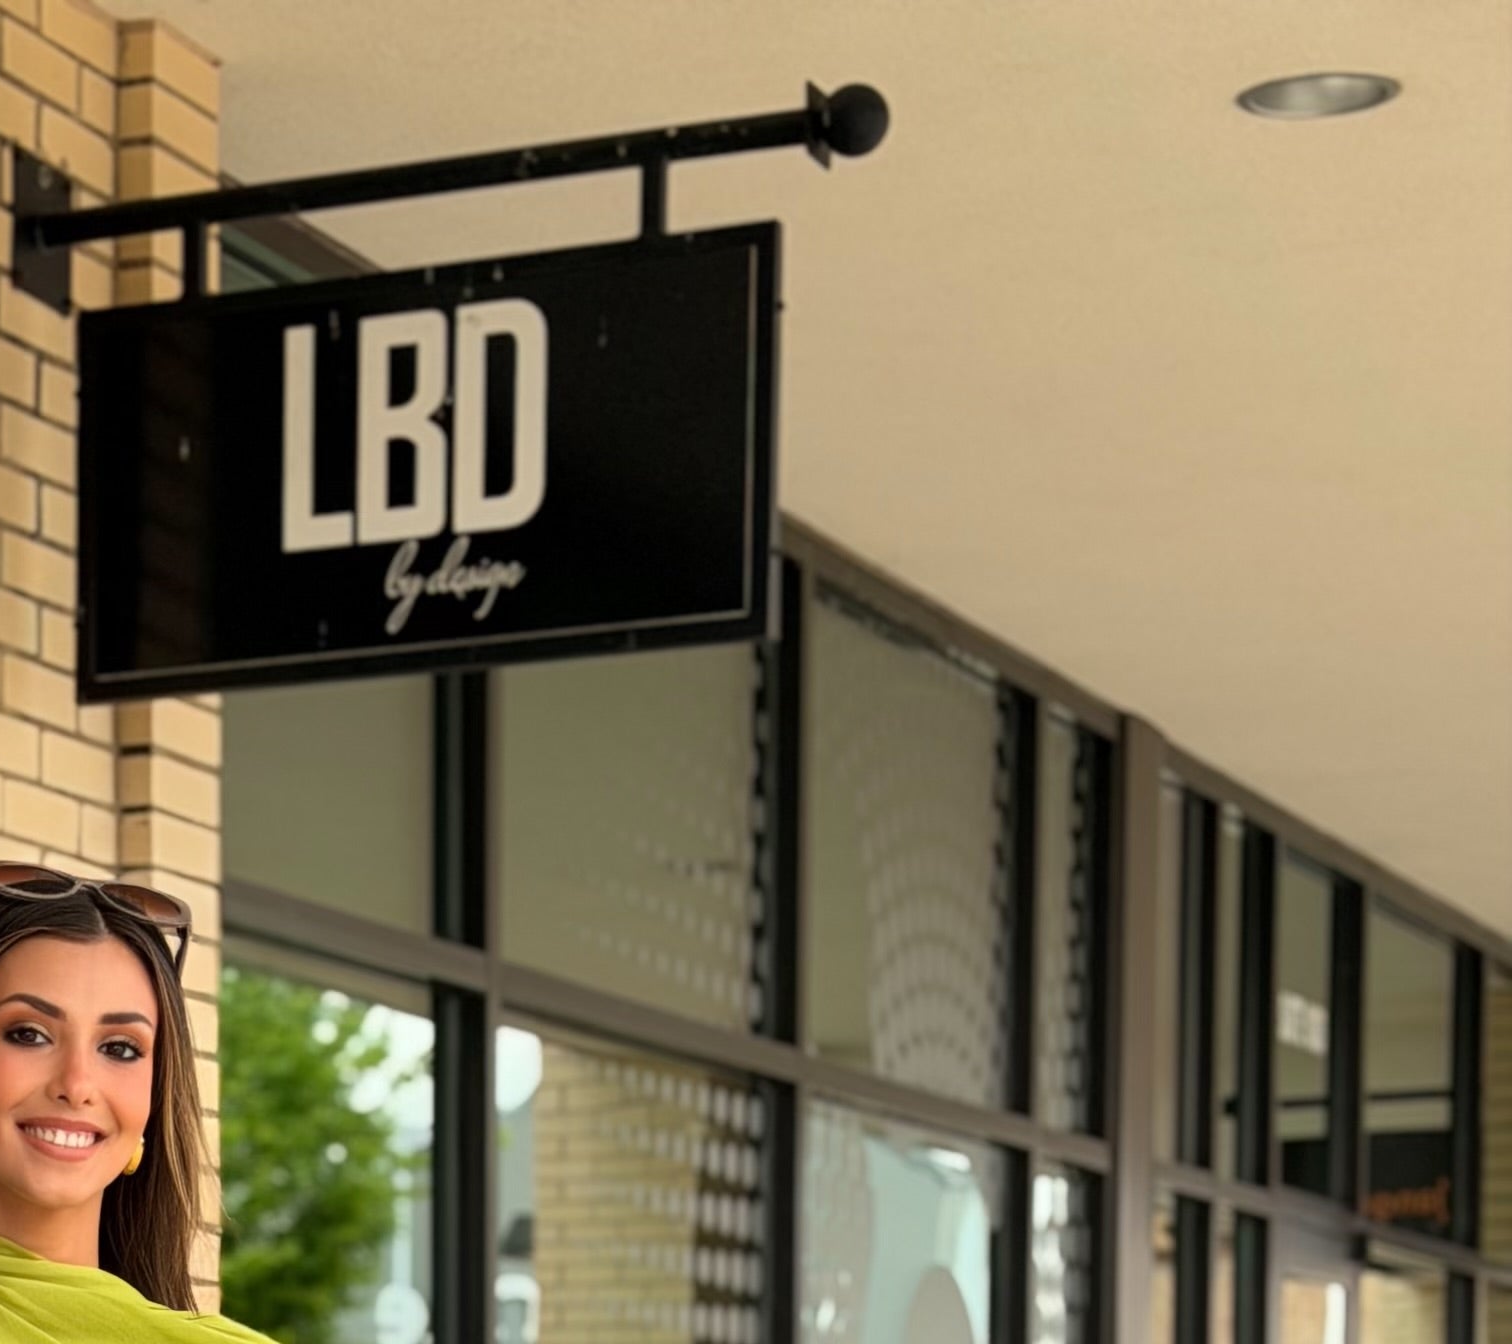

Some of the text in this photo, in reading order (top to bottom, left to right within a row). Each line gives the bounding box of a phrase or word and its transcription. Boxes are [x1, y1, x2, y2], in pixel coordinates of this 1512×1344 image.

[283, 299, 547, 552] LBD
[384, 535, 526, 635] by design
